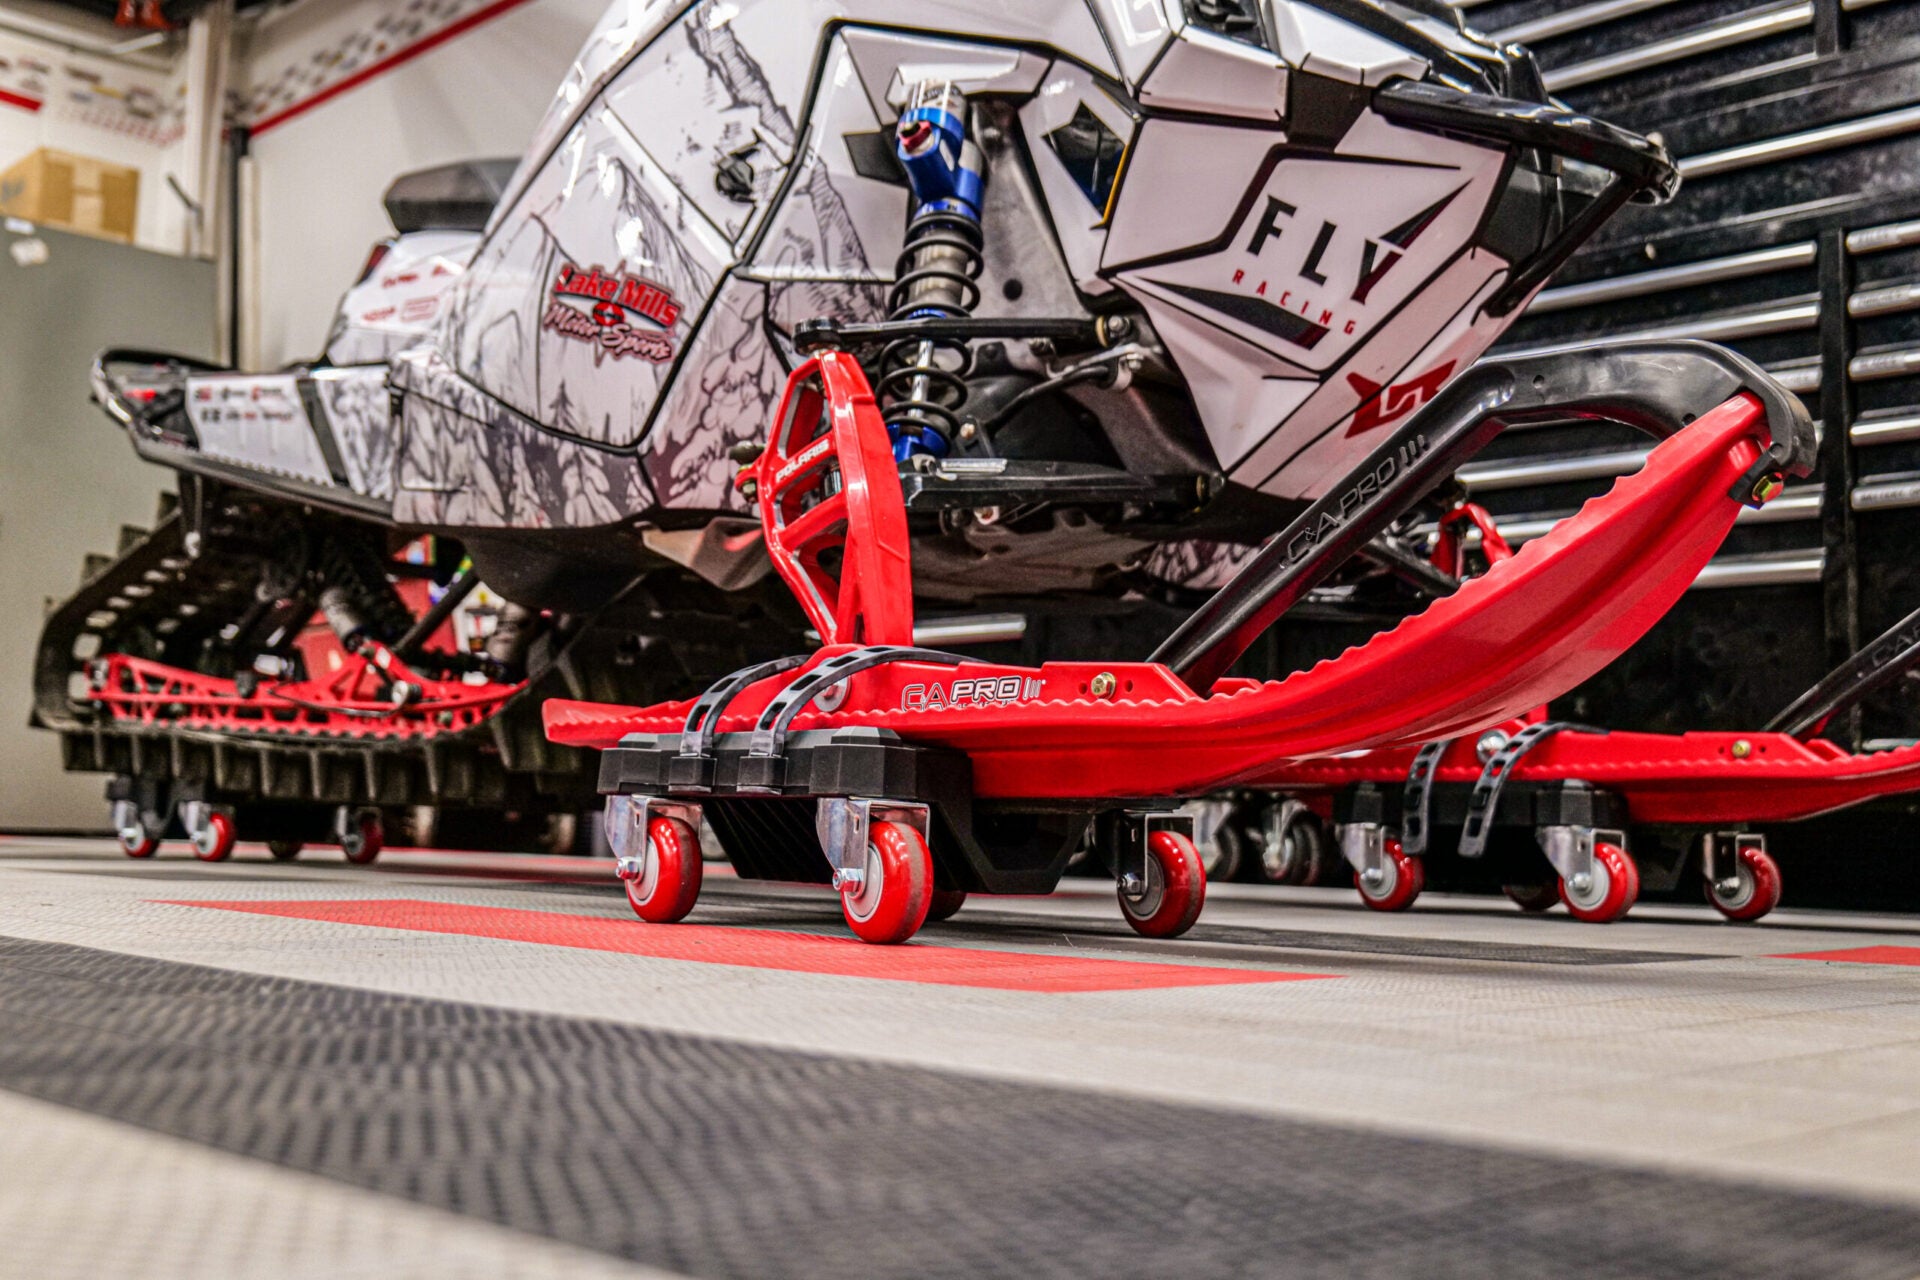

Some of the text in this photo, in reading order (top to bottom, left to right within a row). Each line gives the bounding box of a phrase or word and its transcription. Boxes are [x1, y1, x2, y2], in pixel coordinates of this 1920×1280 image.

[1246, 194, 1404, 306] FLY
[555, 268, 680, 327] Lake Mills
[1232, 268, 1357, 335] RACING
[601, 323, 672, 361] Sports
[775, 438, 830, 484] POLARIS
[1339, 456, 1396, 518] PRO
[950, 675, 1022, 703] PRO
